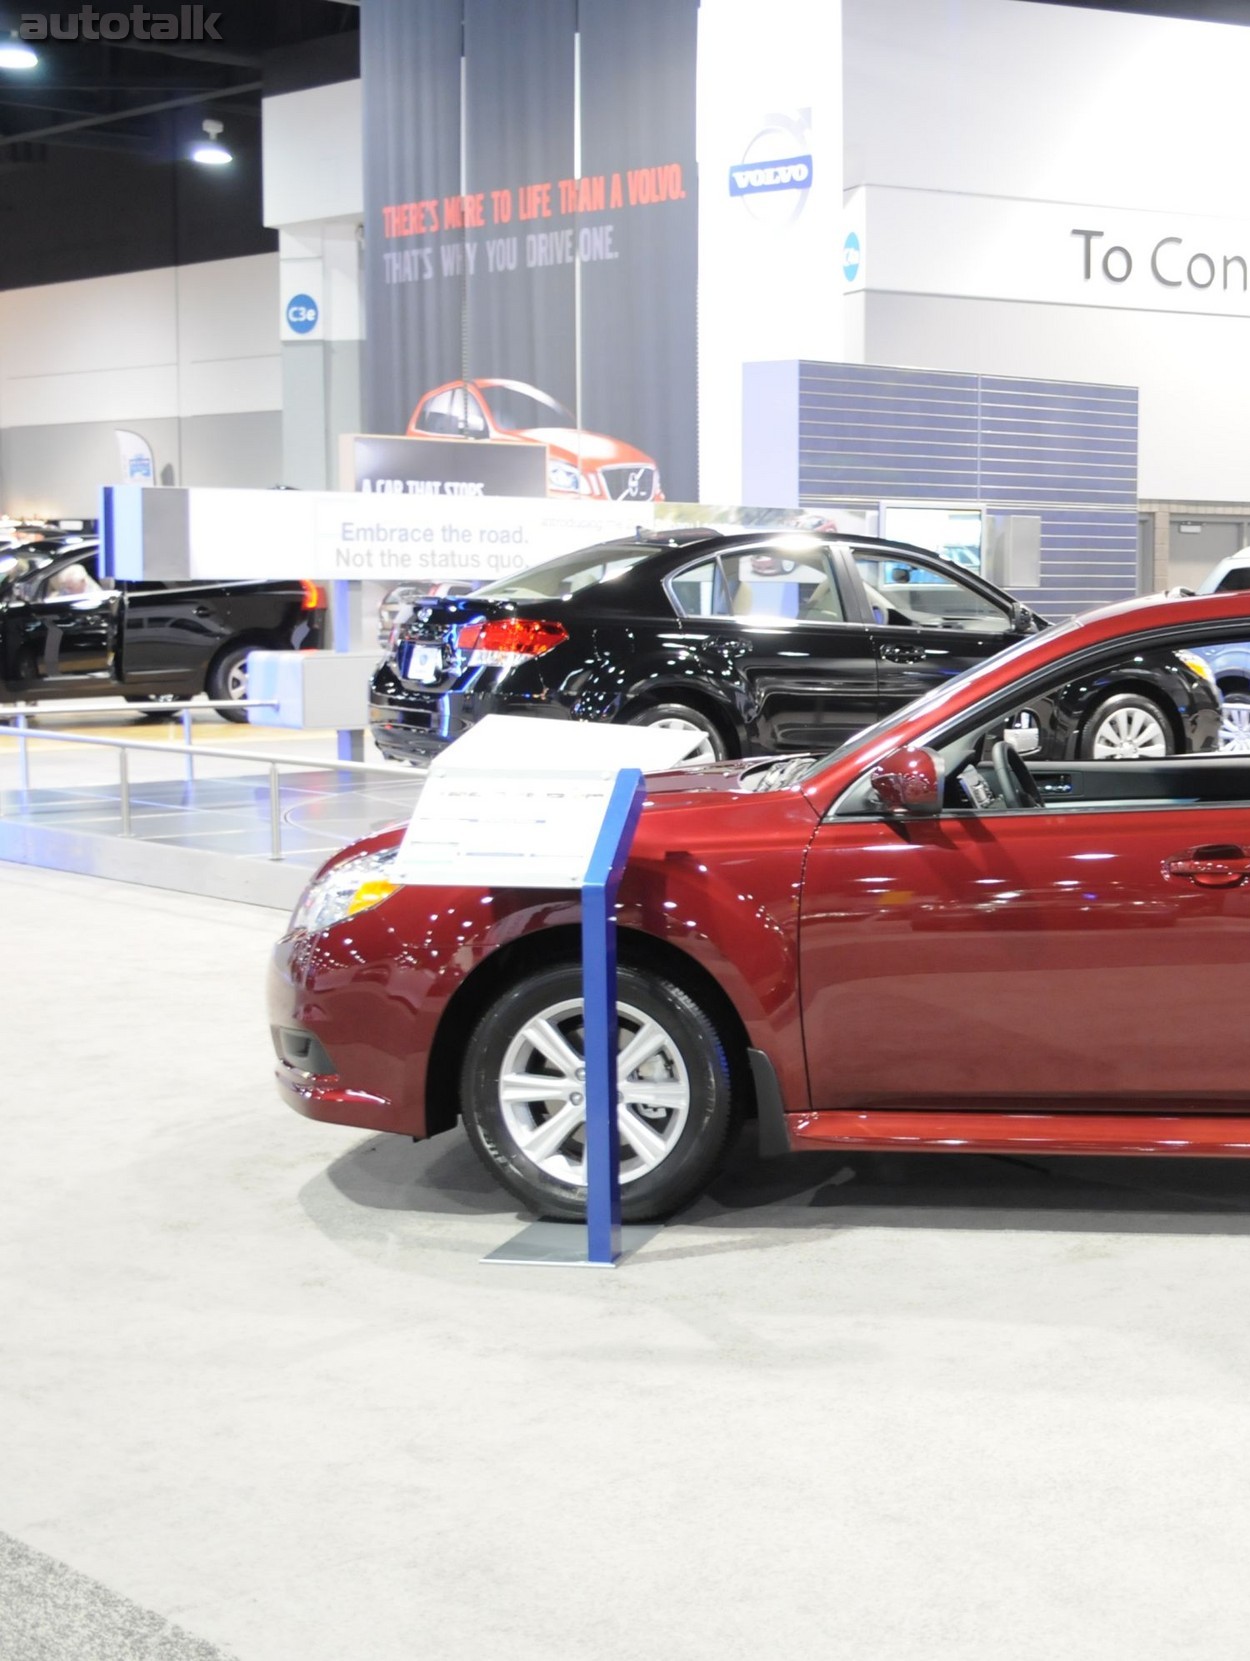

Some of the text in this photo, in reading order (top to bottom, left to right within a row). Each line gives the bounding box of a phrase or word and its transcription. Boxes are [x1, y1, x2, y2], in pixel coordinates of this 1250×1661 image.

[732, 163, 808, 189] VOLVO
[382, 200, 440, 238] THERE'S
[491, 189, 513, 224] TO
[519, 182, 553, 221] LIFE
[611, 173, 623, 208] A
[627, 163, 686, 206] VOLVO.
[383, 247, 434, 284] THAT'S
[486, 237, 519, 273] YOU
[526, 229, 574, 268] DRIVE
[579, 225, 620, 263] ONE.
[1071, 229, 1132, 282] To
[289, 306, 316, 322] C3e
[341, 522, 528, 544] Embrace the road.
[335, 547, 529, 573] Not the status quo.
